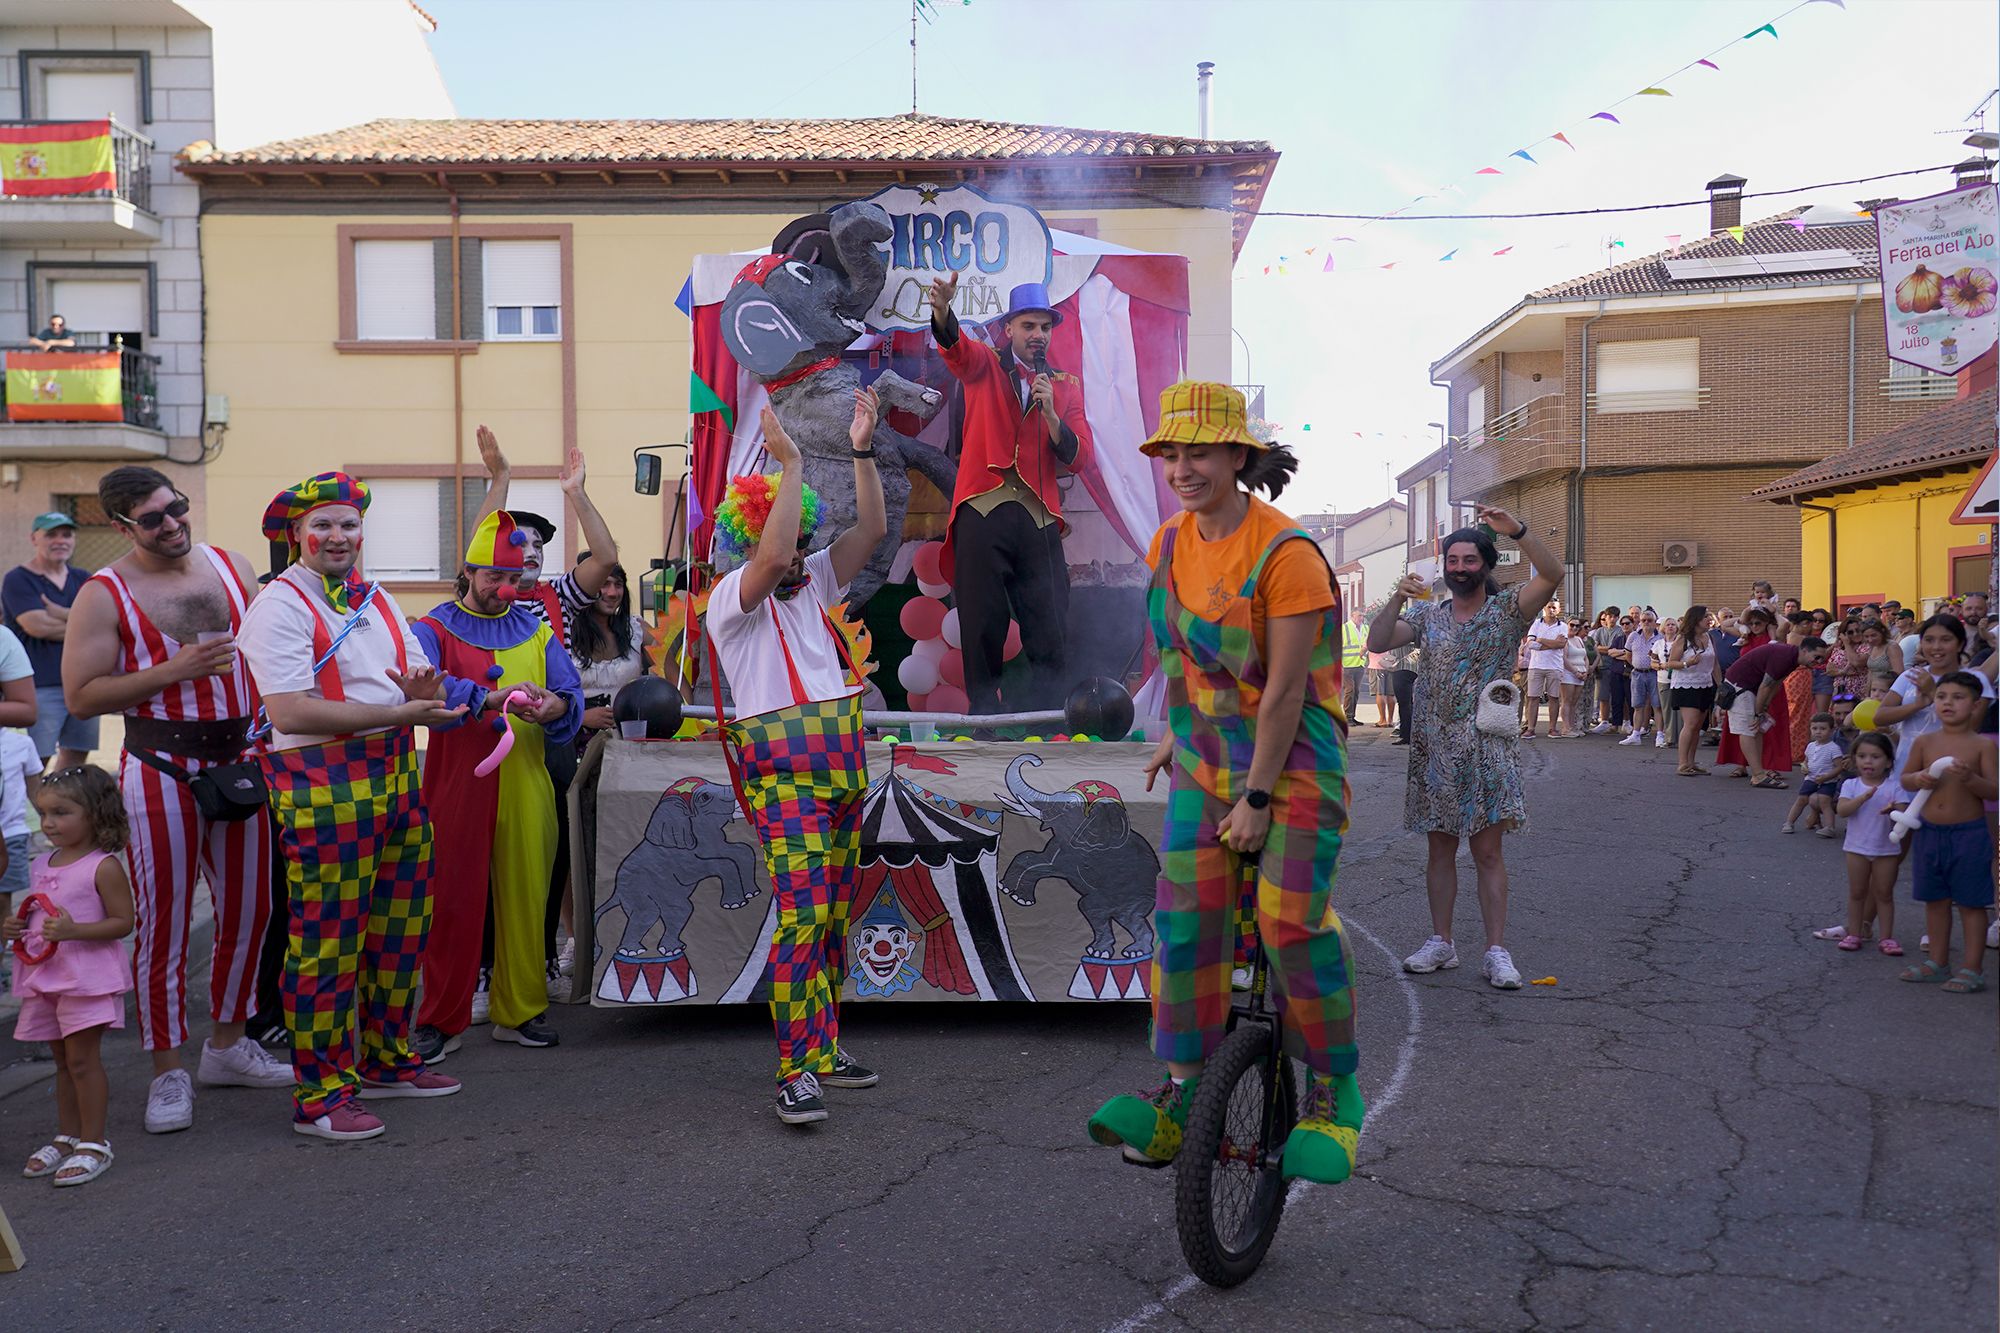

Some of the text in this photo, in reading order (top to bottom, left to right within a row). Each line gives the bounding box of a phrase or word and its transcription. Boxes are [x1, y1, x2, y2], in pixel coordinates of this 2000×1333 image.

[879, 210, 1009, 274] IRCO
[1889, 233, 1994, 264] Feria del Ajo
[1903, 237, 1922, 246] SANTA
[1924, 233, 1950, 242] MARINA
[1965, 227, 1977, 235] REY
[1905, 325, 1919, 335] 18
